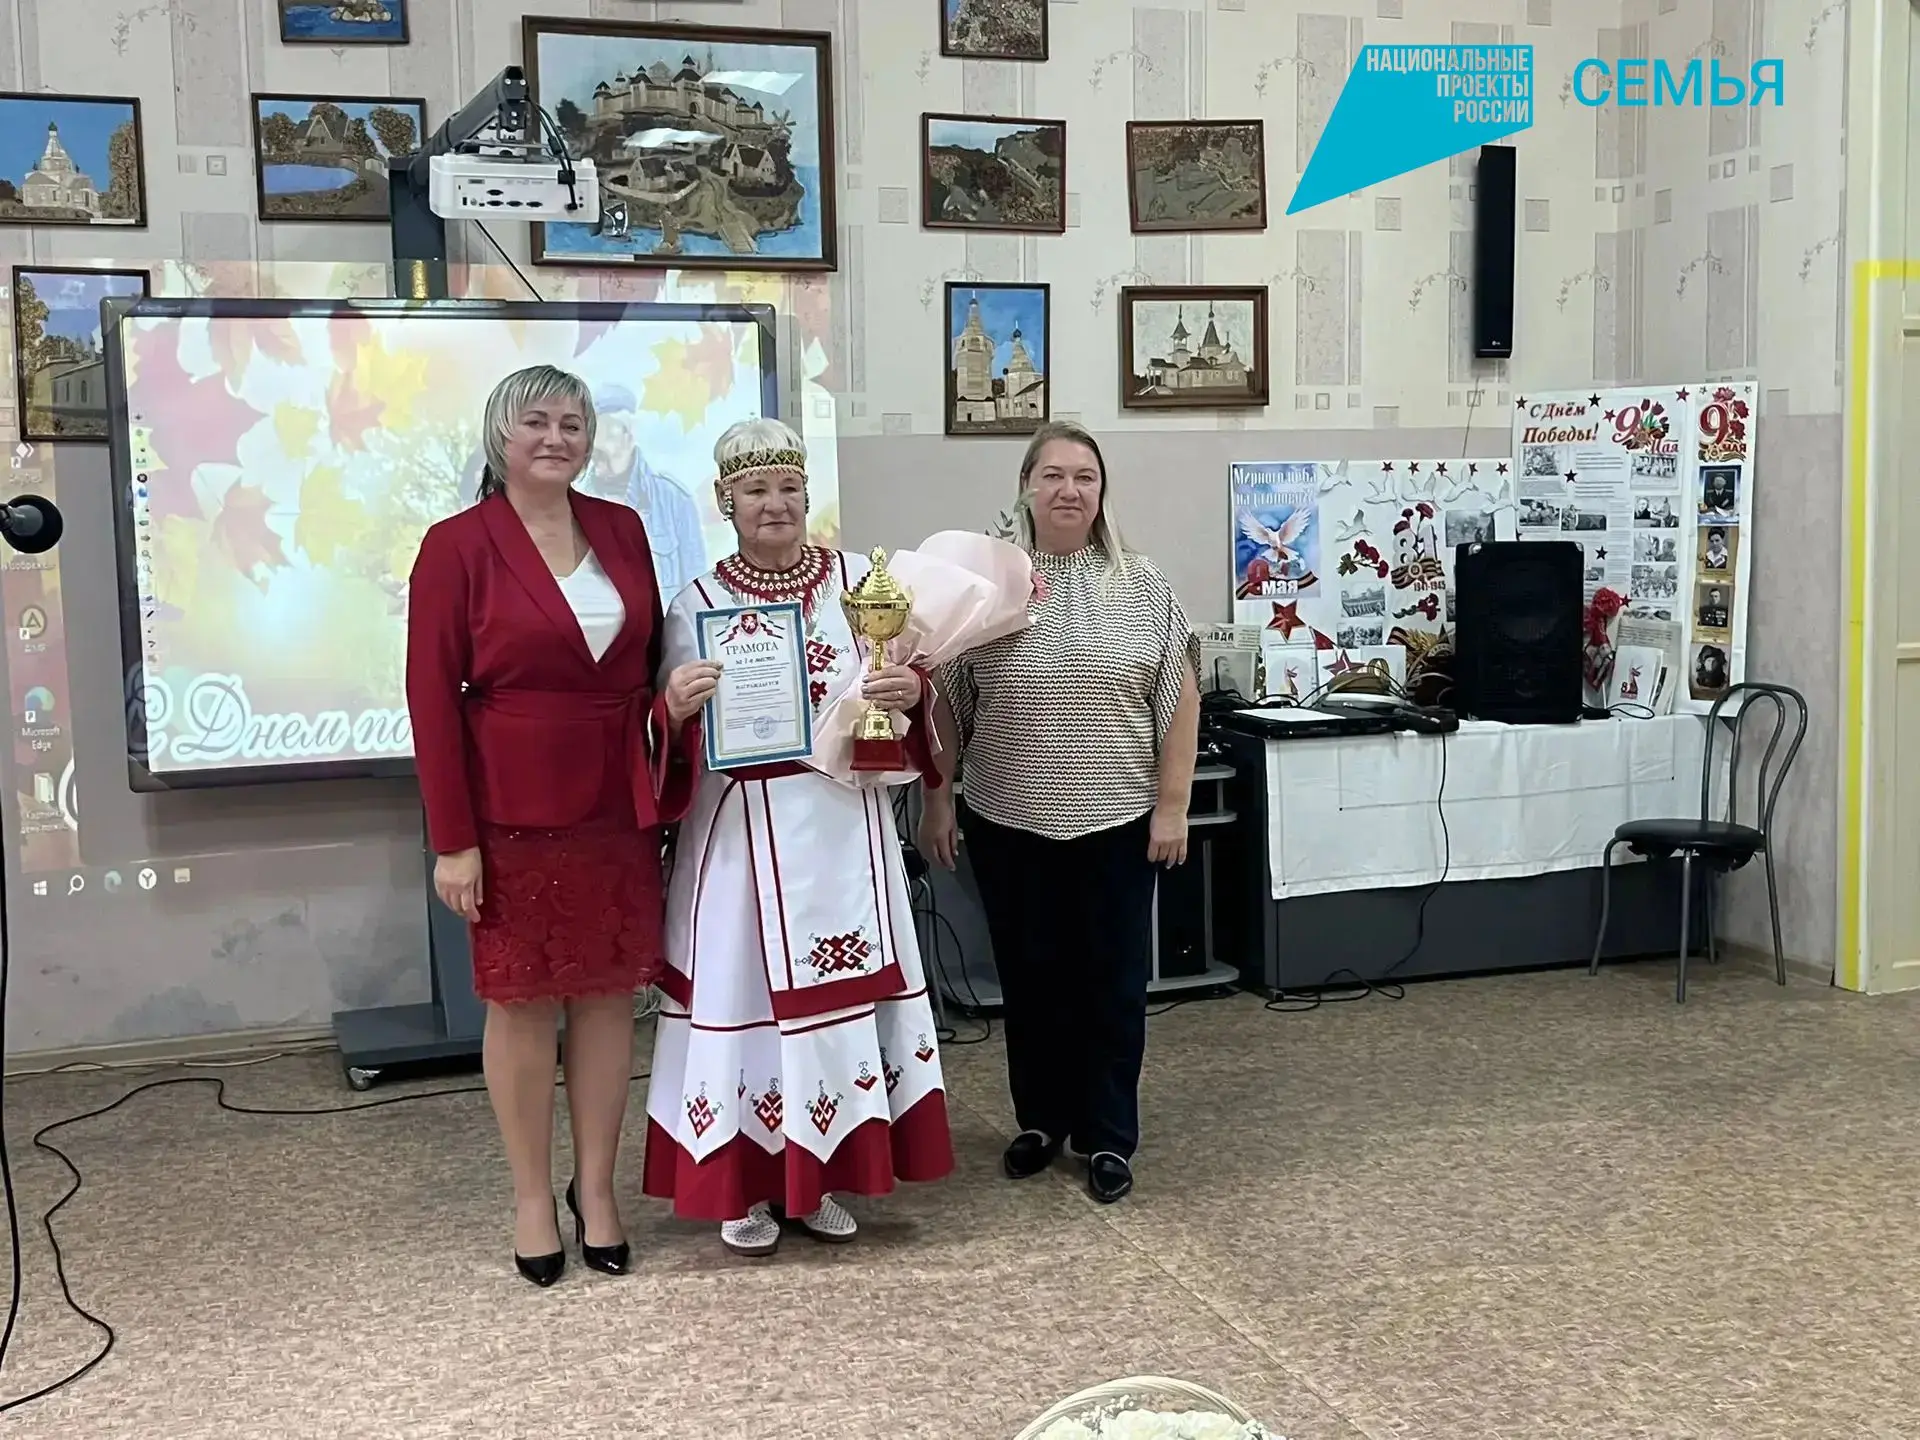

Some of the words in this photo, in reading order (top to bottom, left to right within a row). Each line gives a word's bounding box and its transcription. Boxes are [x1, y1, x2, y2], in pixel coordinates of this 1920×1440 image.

[1530, 404, 1539, 418] С
[1542, 401, 1586, 420] Днём
[1522, 422, 1600, 444] Победы!
[1612, 405, 1641, 443] 9
[1700, 403, 1728, 445] 9
[726, 641, 779, 655] ГРАМОТА
[174, 678, 349, 757] Днем
[31, 740, 52, 752] Edge
